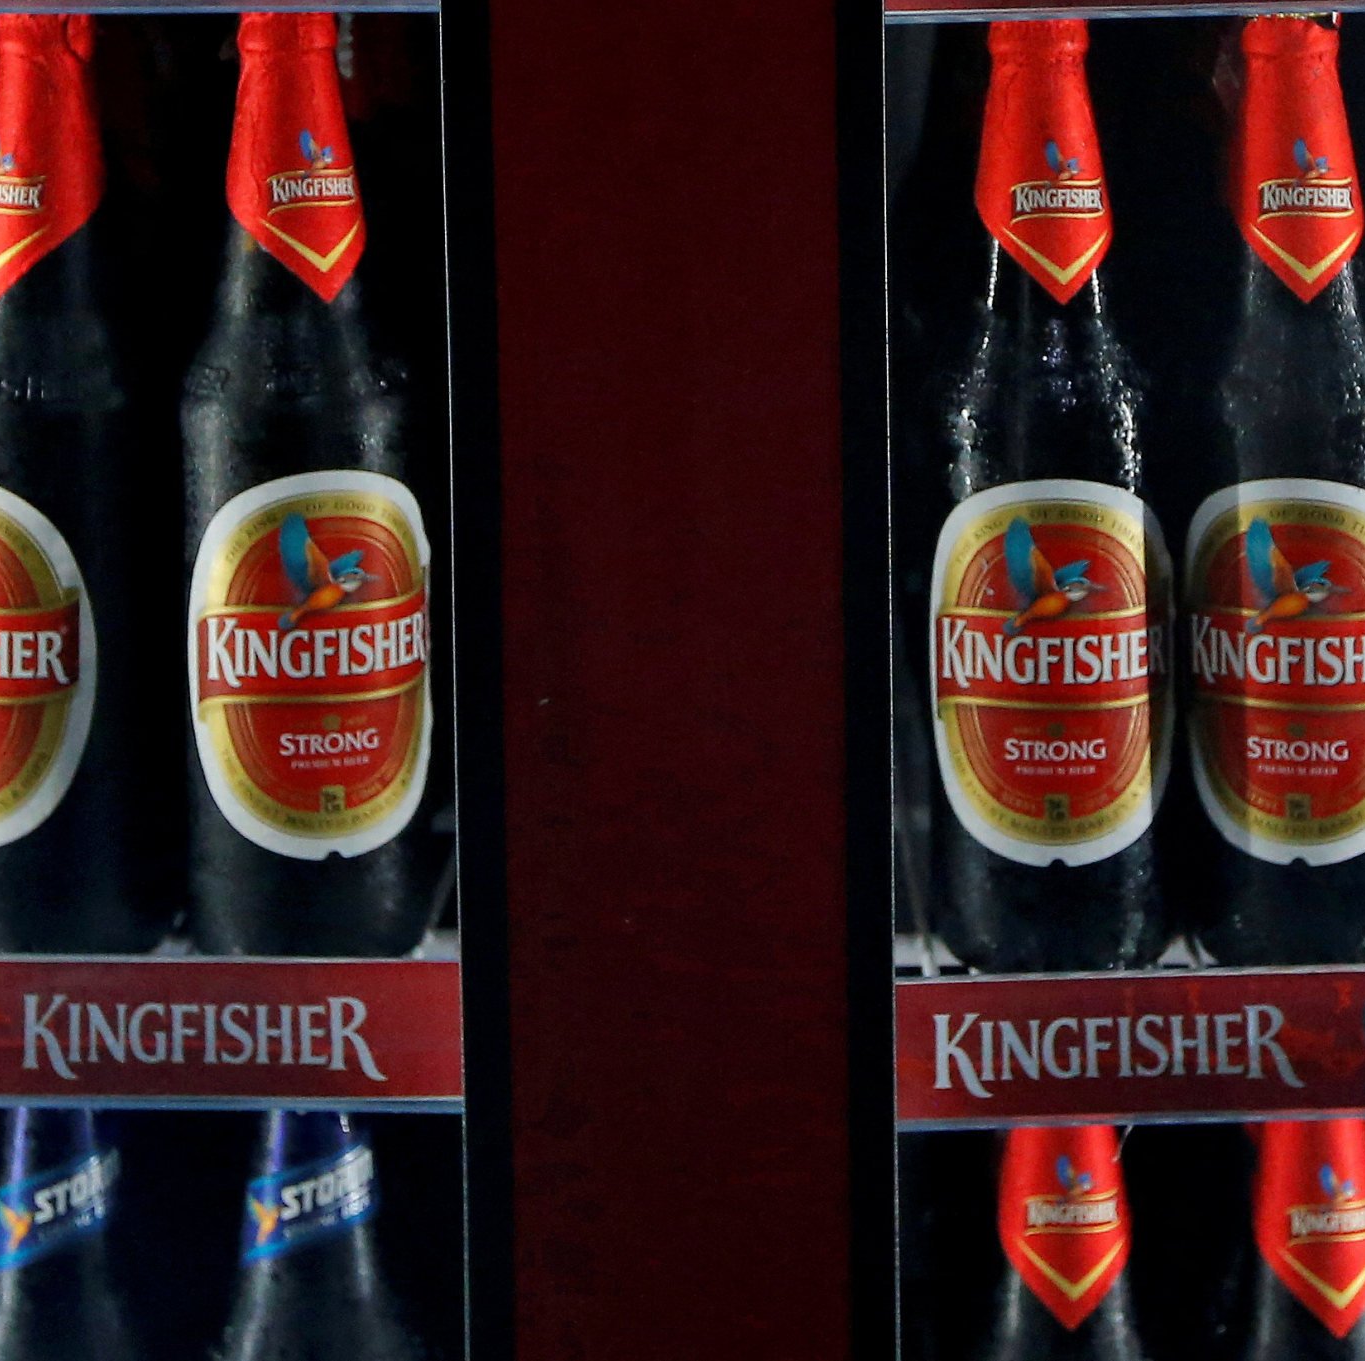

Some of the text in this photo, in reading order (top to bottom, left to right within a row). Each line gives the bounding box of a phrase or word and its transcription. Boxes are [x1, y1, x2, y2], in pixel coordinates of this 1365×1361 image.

[272, 176, 355, 205] KINGFISHER
[1014, 185, 1103, 212] KINGFISHER
[1261, 184, 1352, 211] KINGFISHER
[206, 611, 427, 689] KINGFISHER
[941, 616, 1167, 688] KINGFISHER
[278, 728, 379, 757] STRONG
[1004, 738, 1107, 762] STRONG
[1247, 736, 1349, 762] STRONG
[23, 993, 387, 1082] KINGFISHER
[934, 1003, 1304, 1099] KINGFISHER
